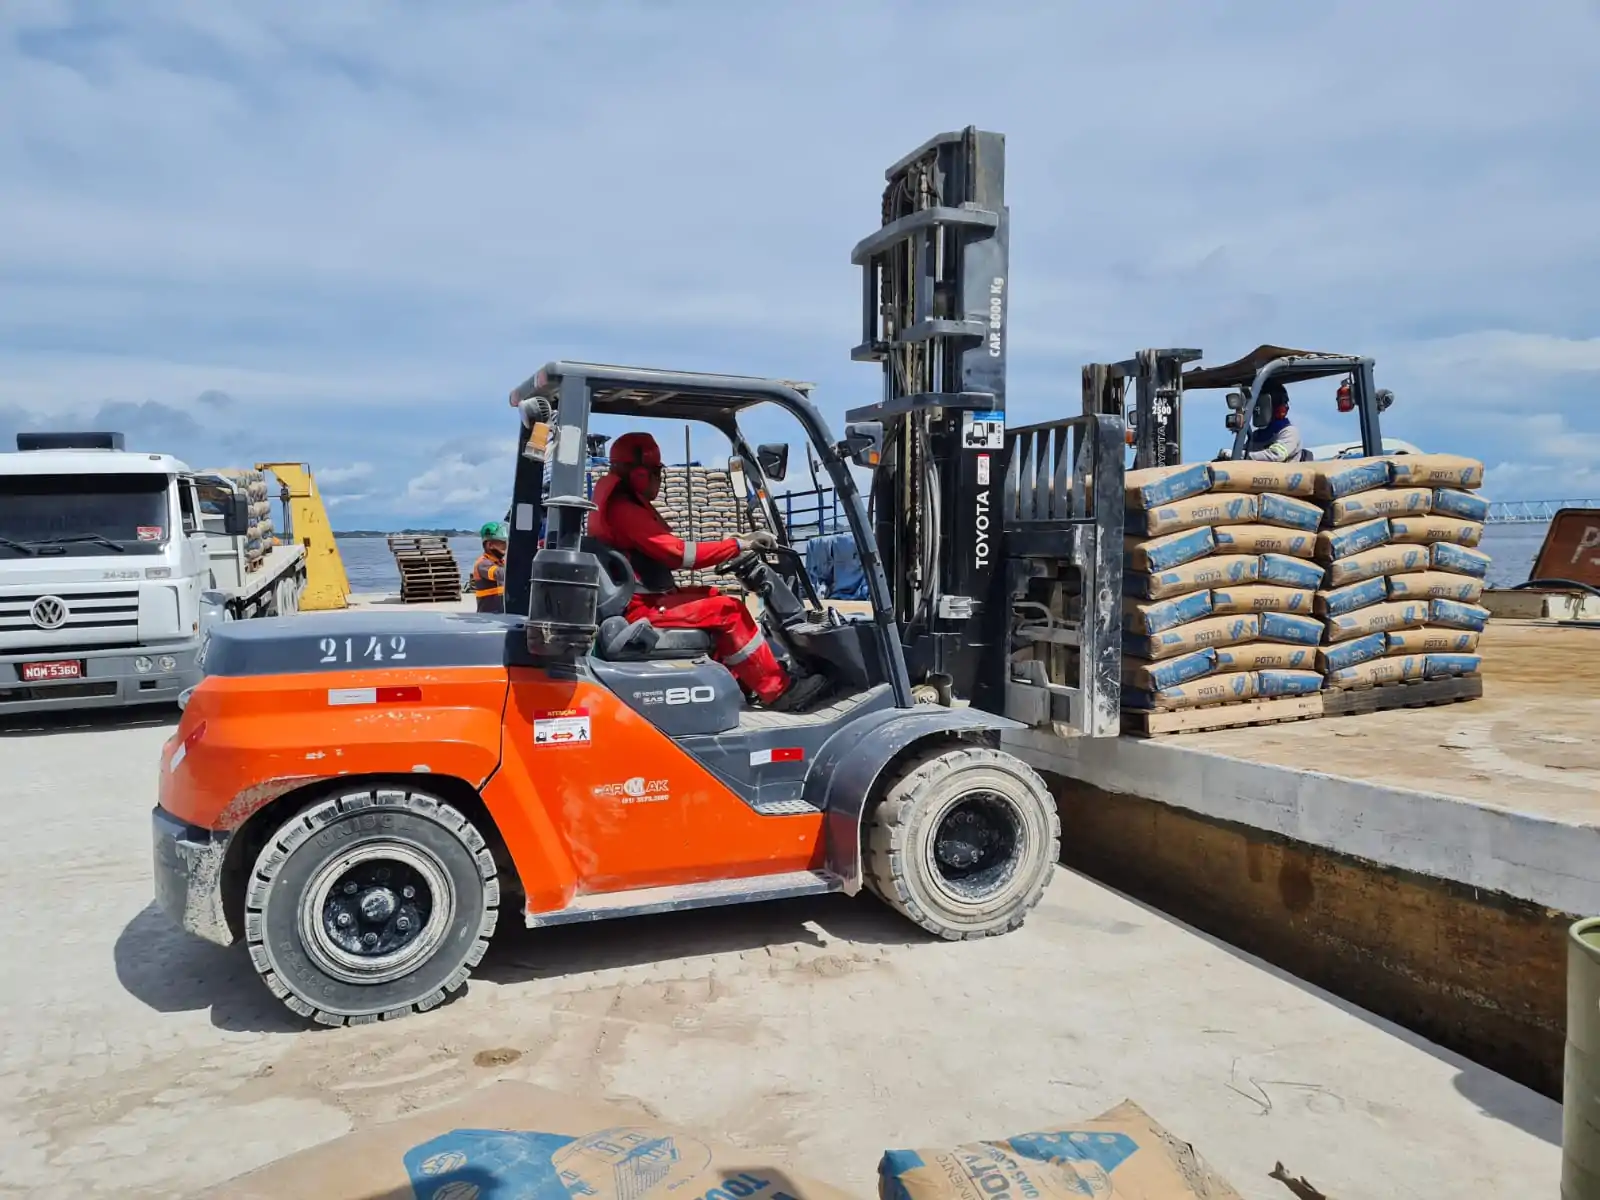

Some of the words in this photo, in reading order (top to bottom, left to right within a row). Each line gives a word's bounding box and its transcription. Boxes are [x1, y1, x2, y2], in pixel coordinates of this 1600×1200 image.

[990, 277, 1004, 294] Kg
[989, 297, 1001, 330] 8000
[1152, 406, 1172, 415] 2500
[1253, 477, 1273, 485] POTY
[1192, 508, 1212, 518] POTY
[976, 490, 990, 569] TOYOTA
[1195, 631, 1215, 641] POTY
[320, 636, 407, 663] 2142
[1255, 656, 1275, 664] POTY
[666, 686, 715, 705] 80
[1198, 687, 1218, 696] POTY
